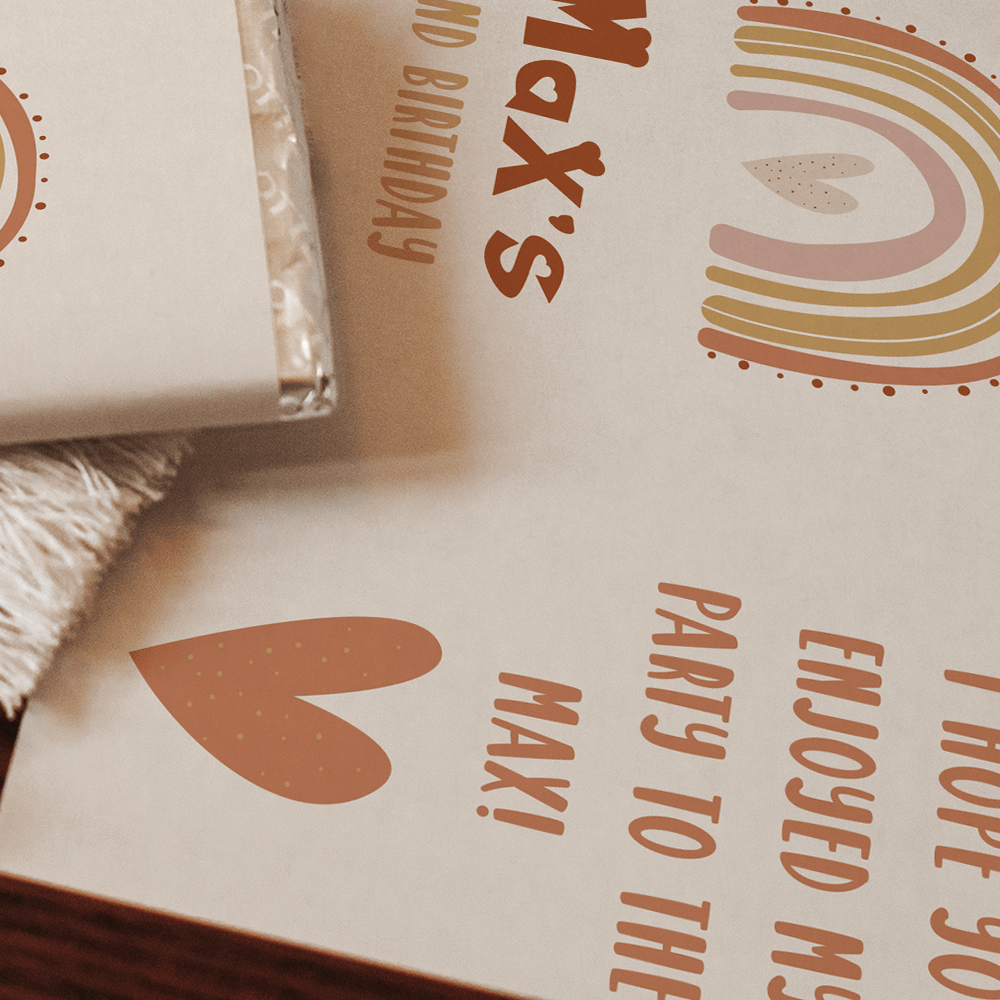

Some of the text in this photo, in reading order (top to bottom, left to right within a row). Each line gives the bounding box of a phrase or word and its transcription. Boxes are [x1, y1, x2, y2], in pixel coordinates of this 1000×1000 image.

[476, 672, 582, 836] MAX!
[628, 786, 722, 860] TO
[779, 629, 885, 893] ENJOYED
[934, 720, 1000, 878] HOPE
[609, 892, 711, 1000] THE
